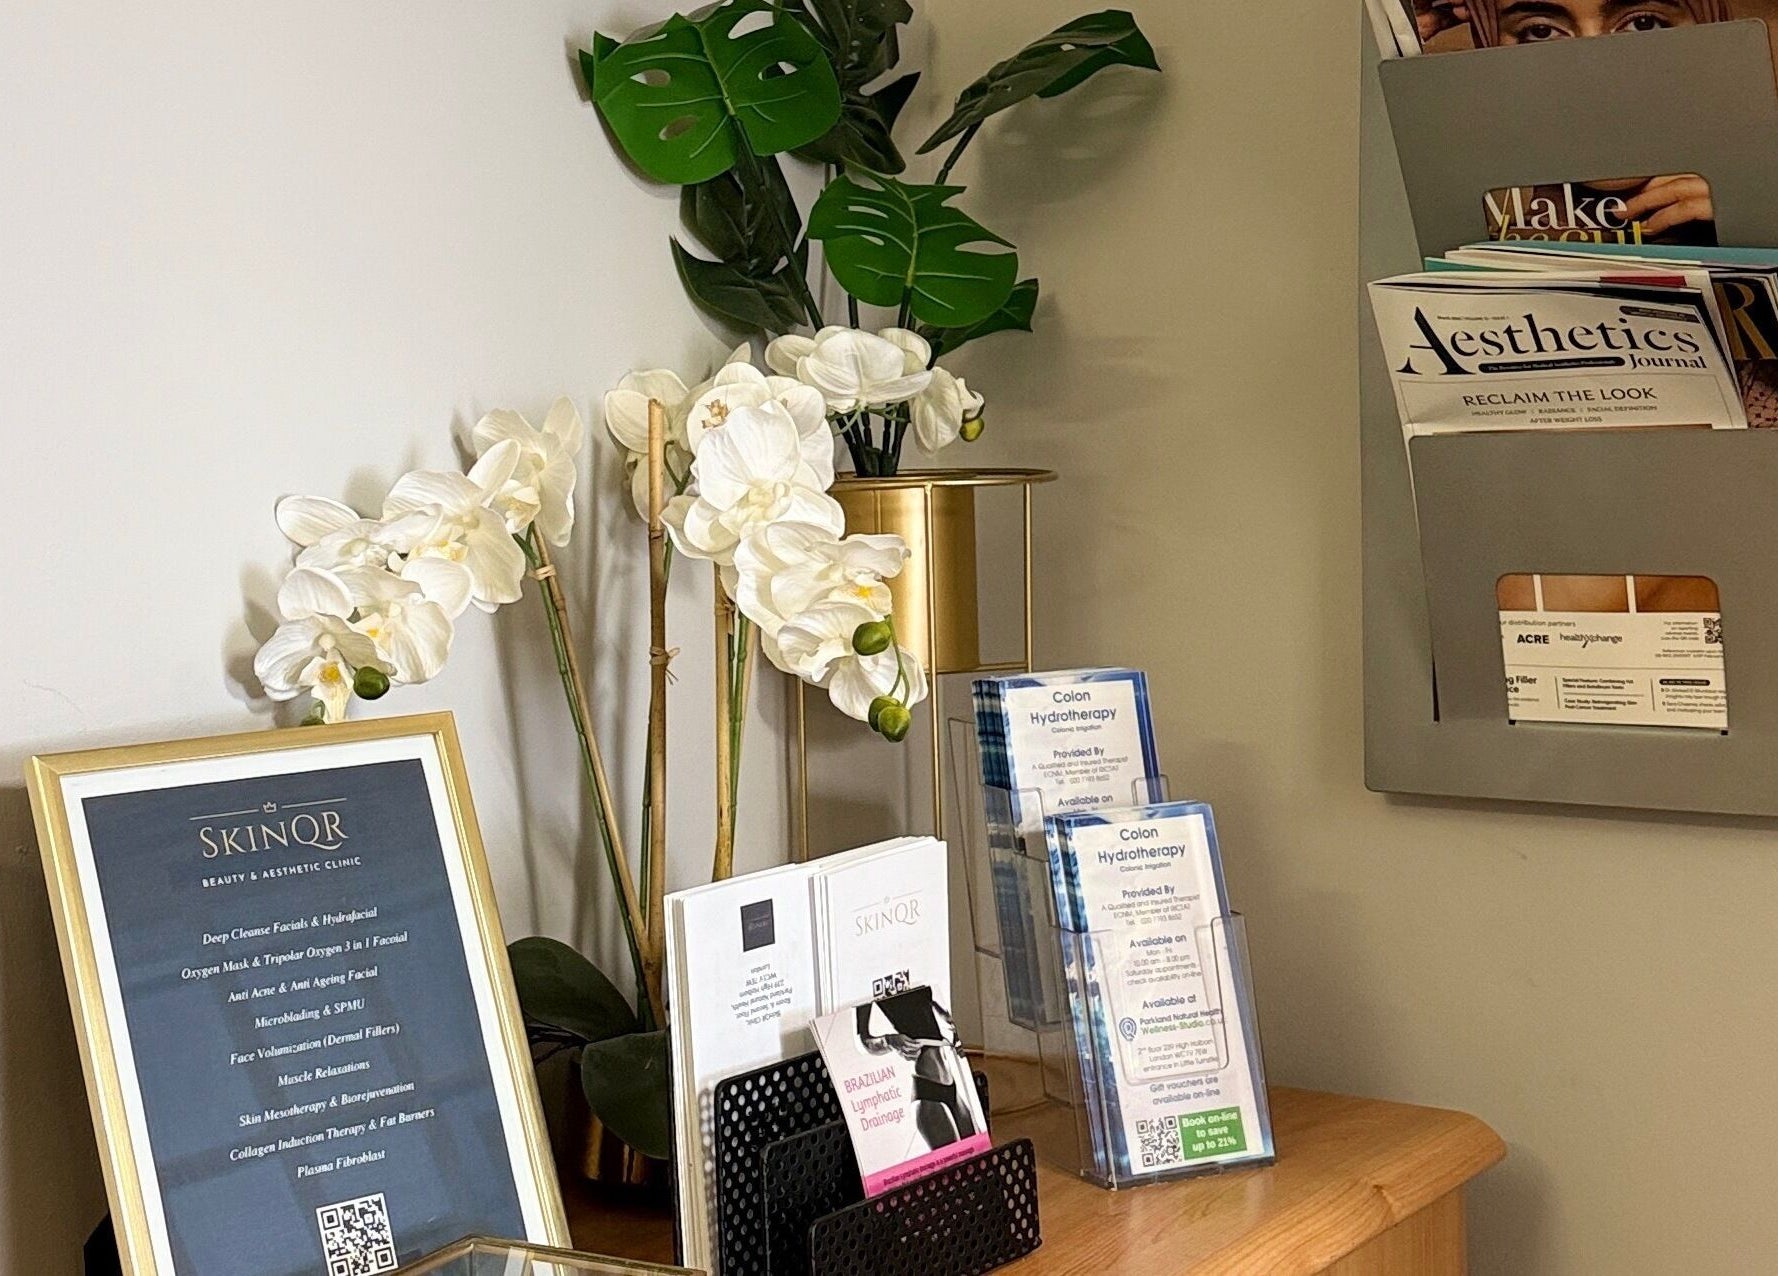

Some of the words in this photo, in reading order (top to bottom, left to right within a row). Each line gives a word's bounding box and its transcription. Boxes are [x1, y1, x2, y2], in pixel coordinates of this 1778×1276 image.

[1395, 306, 1700, 375] Aesthetics
[1628, 353, 1707, 370] Journal
[1463, 391, 1550, 407] RECLAIM
[1553, 389, 1596, 402] THE
[1600, 387, 1658, 400] LOOK
[1517, 634, 1550, 644] ACRE
[1516, 676, 1537, 684] Filler
[1052, 689, 1091, 704] Colon
[1030, 707, 1117, 725] Hydrotherapy
[1051, 726, 1075, 734] Colonic
[1053, 748, 1092, 759] Provided
[1093, 747, 1105, 756] By
[1058, 795, 1099, 807] Available
[1101, 794, 1113, 802] on
[200, 811, 349, 859] SKINQR
[1119, 826, 1159, 841] Colon
[1098, 844, 1186, 865] Hydrotherapy
[201, 873, 246, 888] BEAUTY
[250, 872, 258, 881] &
[262, 862, 321, 879] AESTHETIC
[324, 856, 362, 870] CLINIC
[1119, 864, 1143, 873] Colonic
[1122, 886, 1162, 898] Provided
[1164, 885, 1175, 895] By
[855, 898, 921, 937] SKINQR
[202, 932, 229, 946] Deep
[231, 925, 271, 940] Cleanse
[273, 917, 309, 934] Facials
[311, 916, 320, 928] &
[322, 907, 378, 927] Hydrafacial
[1130, 936, 1173, 948] Available
[1175, 935, 1187, 943] on
[181, 965, 220, 981] Oxygen
[222, 959, 250, 973] Mask
[252, 957, 261, 967] &
[263, 950, 304, 966] Tripolar
[306, 943, 343, 959] Oxygen
[345, 940, 351, 952] 3
[352, 939, 363, 950] in
[227, 990, 249, 1003] Anti
[250, 985, 276, 999] Acne
[278, 982, 288, 993] &
[290, 978, 310, 992] Anti
[313, 972, 345, 988] Ageing
[348, 966, 378, 982] Facial
[1142, 997, 1186, 1009] Available
[1187, 994, 1196, 1003] at
[254, 1008, 320, 1029] Microblading
[322, 1005, 331, 1016] &
[333, 998, 365, 1015] SPMU
[1139, 1014, 1172, 1025] Parkland
[1173, 1011, 1199, 1020] Natural
[230, 1053, 255, 1065] Face
[257, 1039, 322, 1059] Volumization
[323, 1031, 363, 1048] (Dermal
[365, 1023, 400, 1039] Fillers)
[1149, 1053, 1173, 1062] London
[278, 1071, 313, 1087] Muscle
[315, 1060, 370, 1079] Relaxations
[843, 1066, 896, 1093] BRAZILIAN
[1149, 1083, 1165, 1093] Gift
[1167, 1078, 1204, 1090] vouchers
[239, 1115, 262, 1127] Skin
[264, 1101, 328, 1122] Mesotherapy
[329, 1096, 338, 1107] &
[341, 1082, 415, 1105] Biorejuvenation
[851, 1086, 902, 1115] Lymphatic
[1152, 1092, 1191, 1105] available
[1193, 1088, 1220, 1098] on-line
[860, 1107, 905, 1131] Drainage
[1182, 1115, 1207, 1128] Book
[1208, 1111, 1238, 1123] on-line
[229, 1143, 276, 1161] Collagen
[278, 1133, 324, 1151] Induction
[326, 1122, 366, 1140] Therapy
[368, 1119, 377, 1130] &
[379, 1115, 397, 1128] Fat
[398, 1107, 435, 1124] Burners
[1196, 1128, 1206, 1138] to
[1208, 1126, 1229, 1137] save
[1192, 1142, 1205, 1153] up
[1206, 1139, 1216, 1149] to
[1217, 1137, 1237, 1148] 21%
[297, 1163, 334, 1178] Plasma
[336, 1149, 386, 1169] Fibroblast
